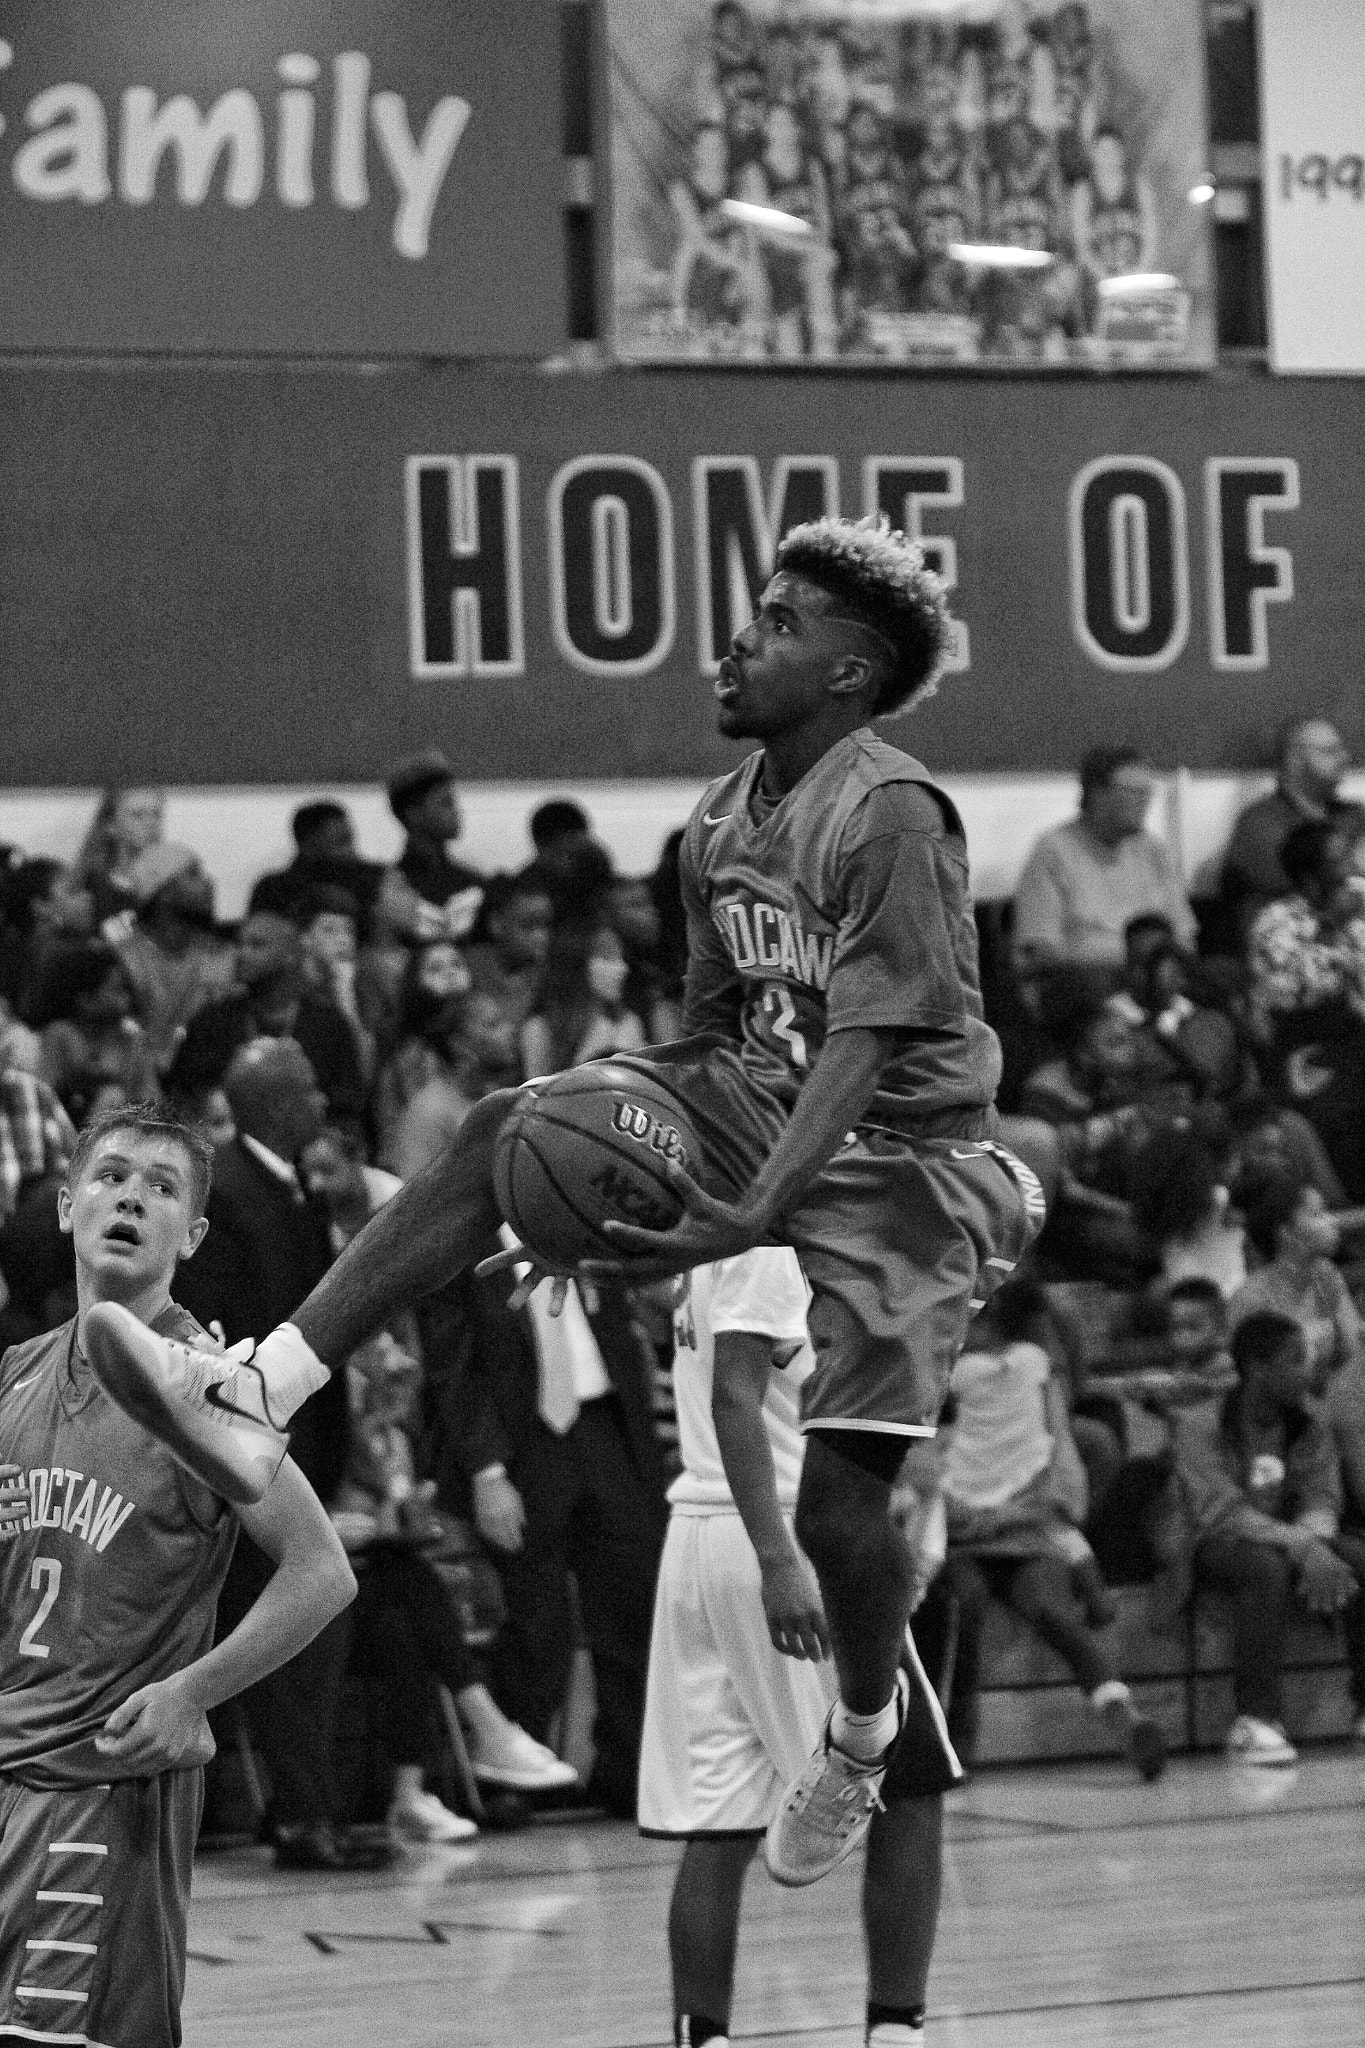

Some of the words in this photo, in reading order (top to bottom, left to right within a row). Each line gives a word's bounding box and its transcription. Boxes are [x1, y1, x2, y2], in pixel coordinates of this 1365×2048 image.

[0, 38, 472, 260] amily
[404, 453, 971, 680] HOME
[1068, 453, 1300, 672] OF
[0, 1467, 136, 1553] HOCTAW
[19, 1556, 62, 1659] 2
